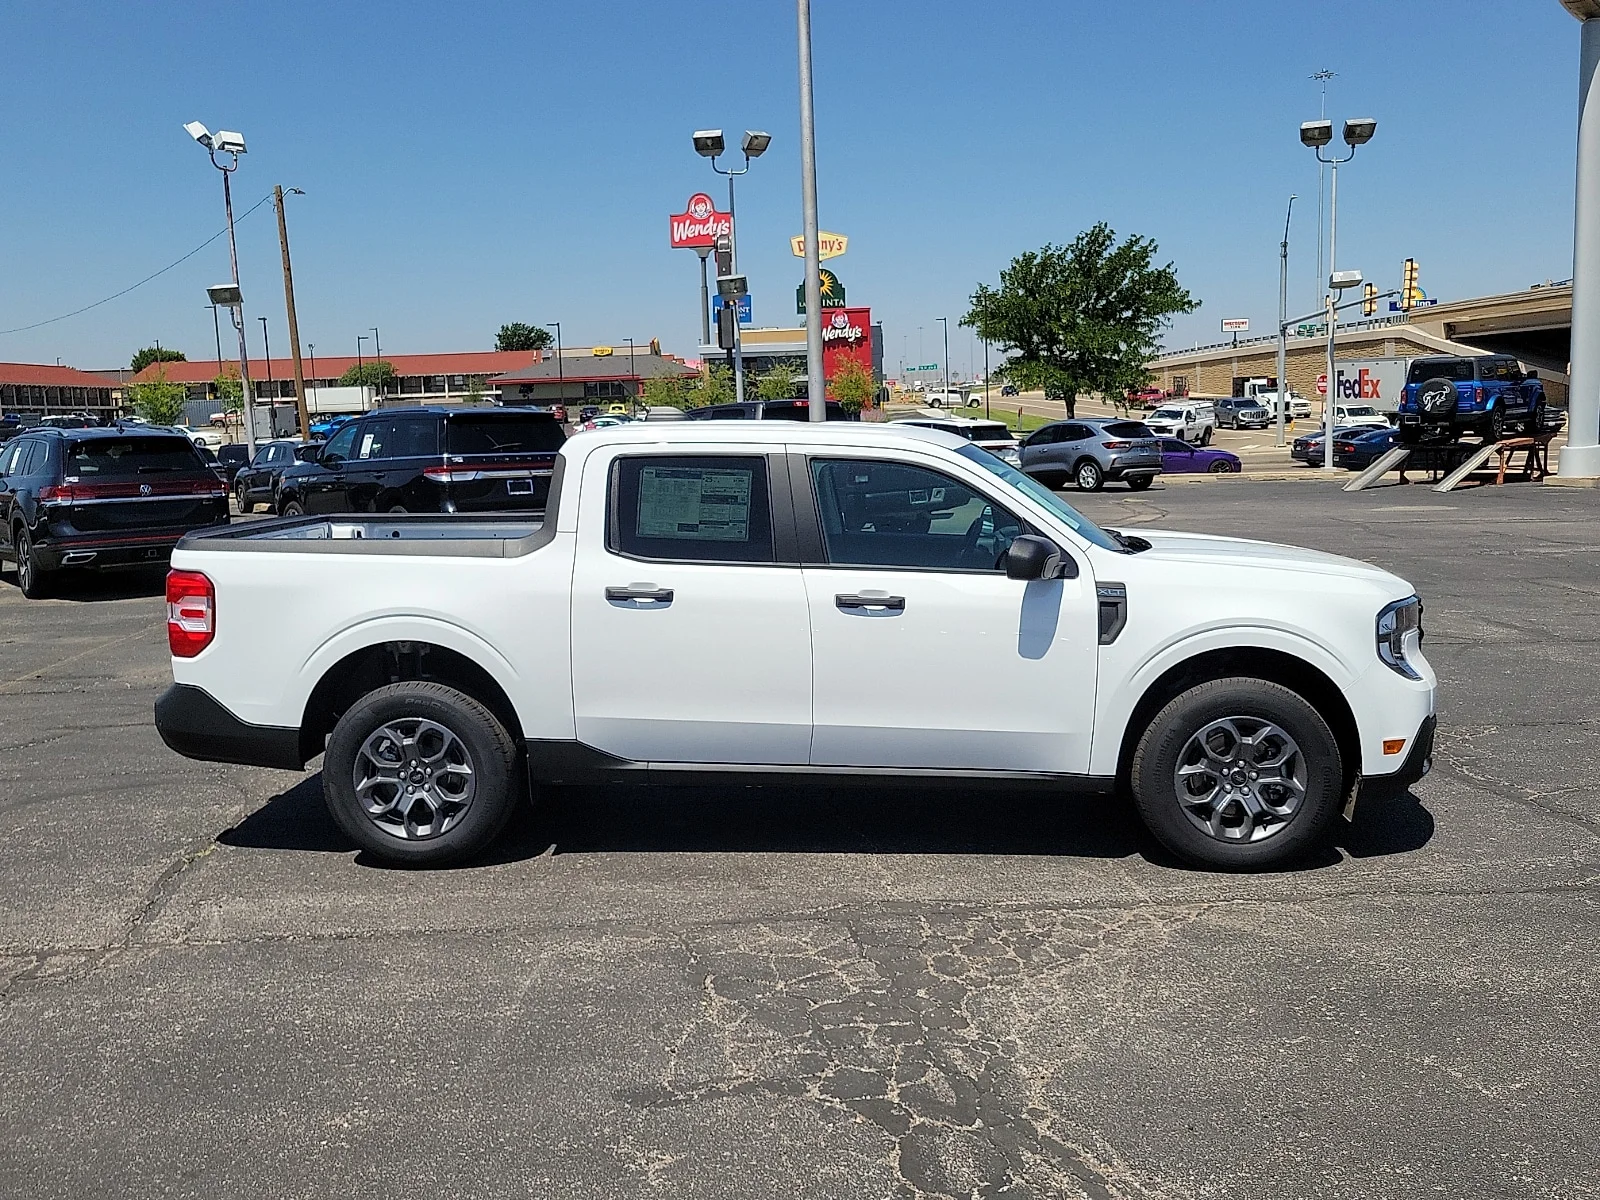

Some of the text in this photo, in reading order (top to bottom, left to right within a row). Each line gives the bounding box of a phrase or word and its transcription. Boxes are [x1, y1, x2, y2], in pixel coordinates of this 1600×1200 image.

[673, 215, 730, 243] Wendy's
[797, 238, 843, 252] Dny's
[822, 298, 845, 307] INTA
[822, 323, 862, 341] Wendy's
[1337, 369, 1381, 398] FedEx
[1098, 588, 1124, 596] XLT
